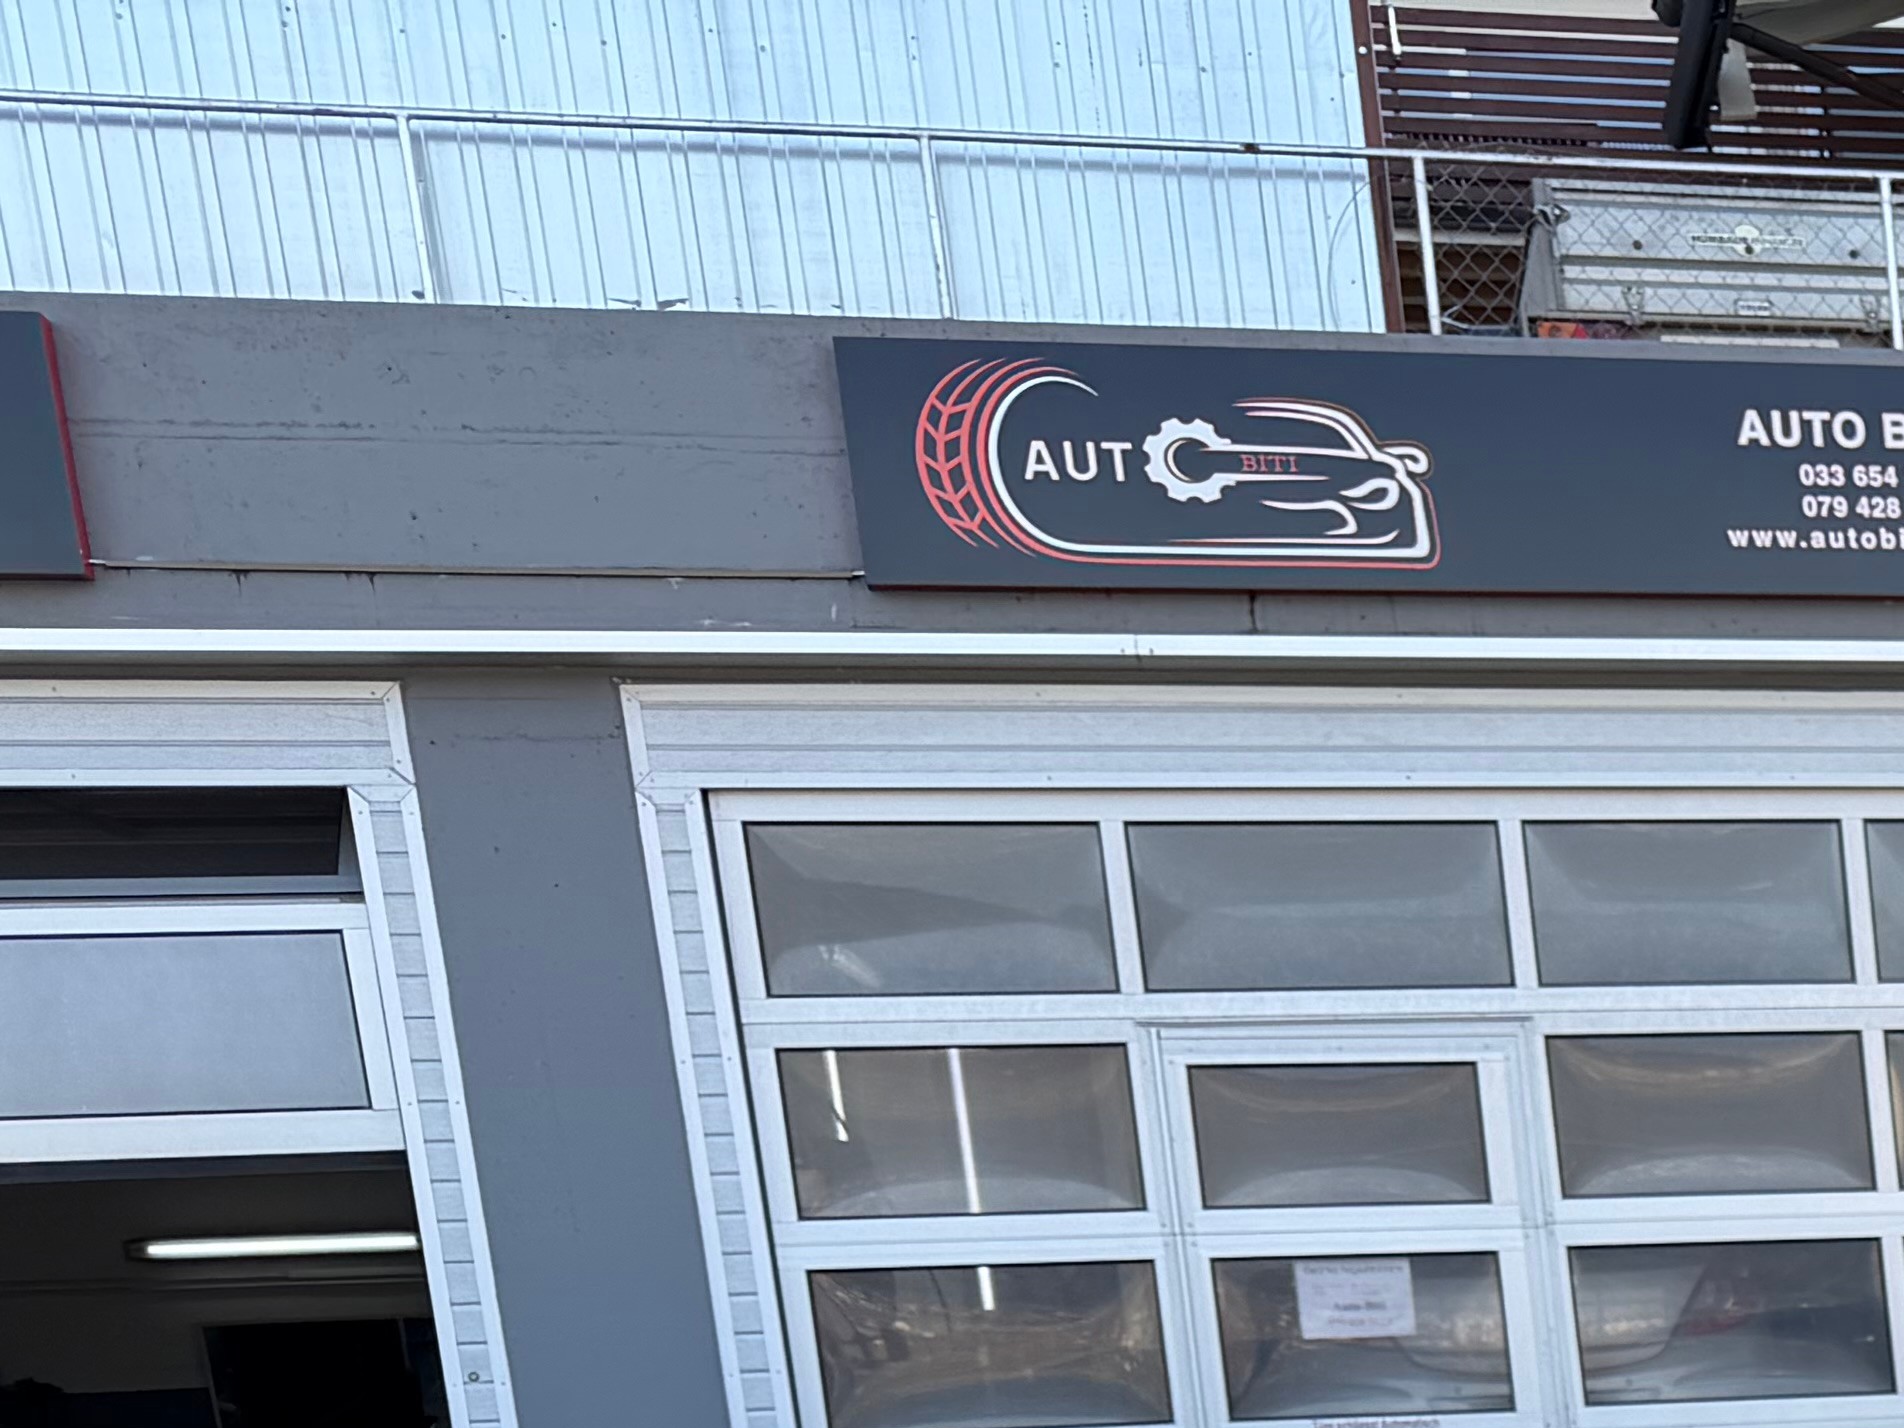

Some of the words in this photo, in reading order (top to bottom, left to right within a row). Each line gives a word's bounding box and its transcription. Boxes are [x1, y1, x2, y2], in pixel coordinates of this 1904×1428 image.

[1737, 409, 1866, 448] AUTO
[1239, 454, 1299, 473] BITI
[1799, 464, 1845, 486] 033
[1852, 465, 1898, 487] 654
[1802, 495, 1848, 518] 079
[1855, 496, 1901, 519] 428
